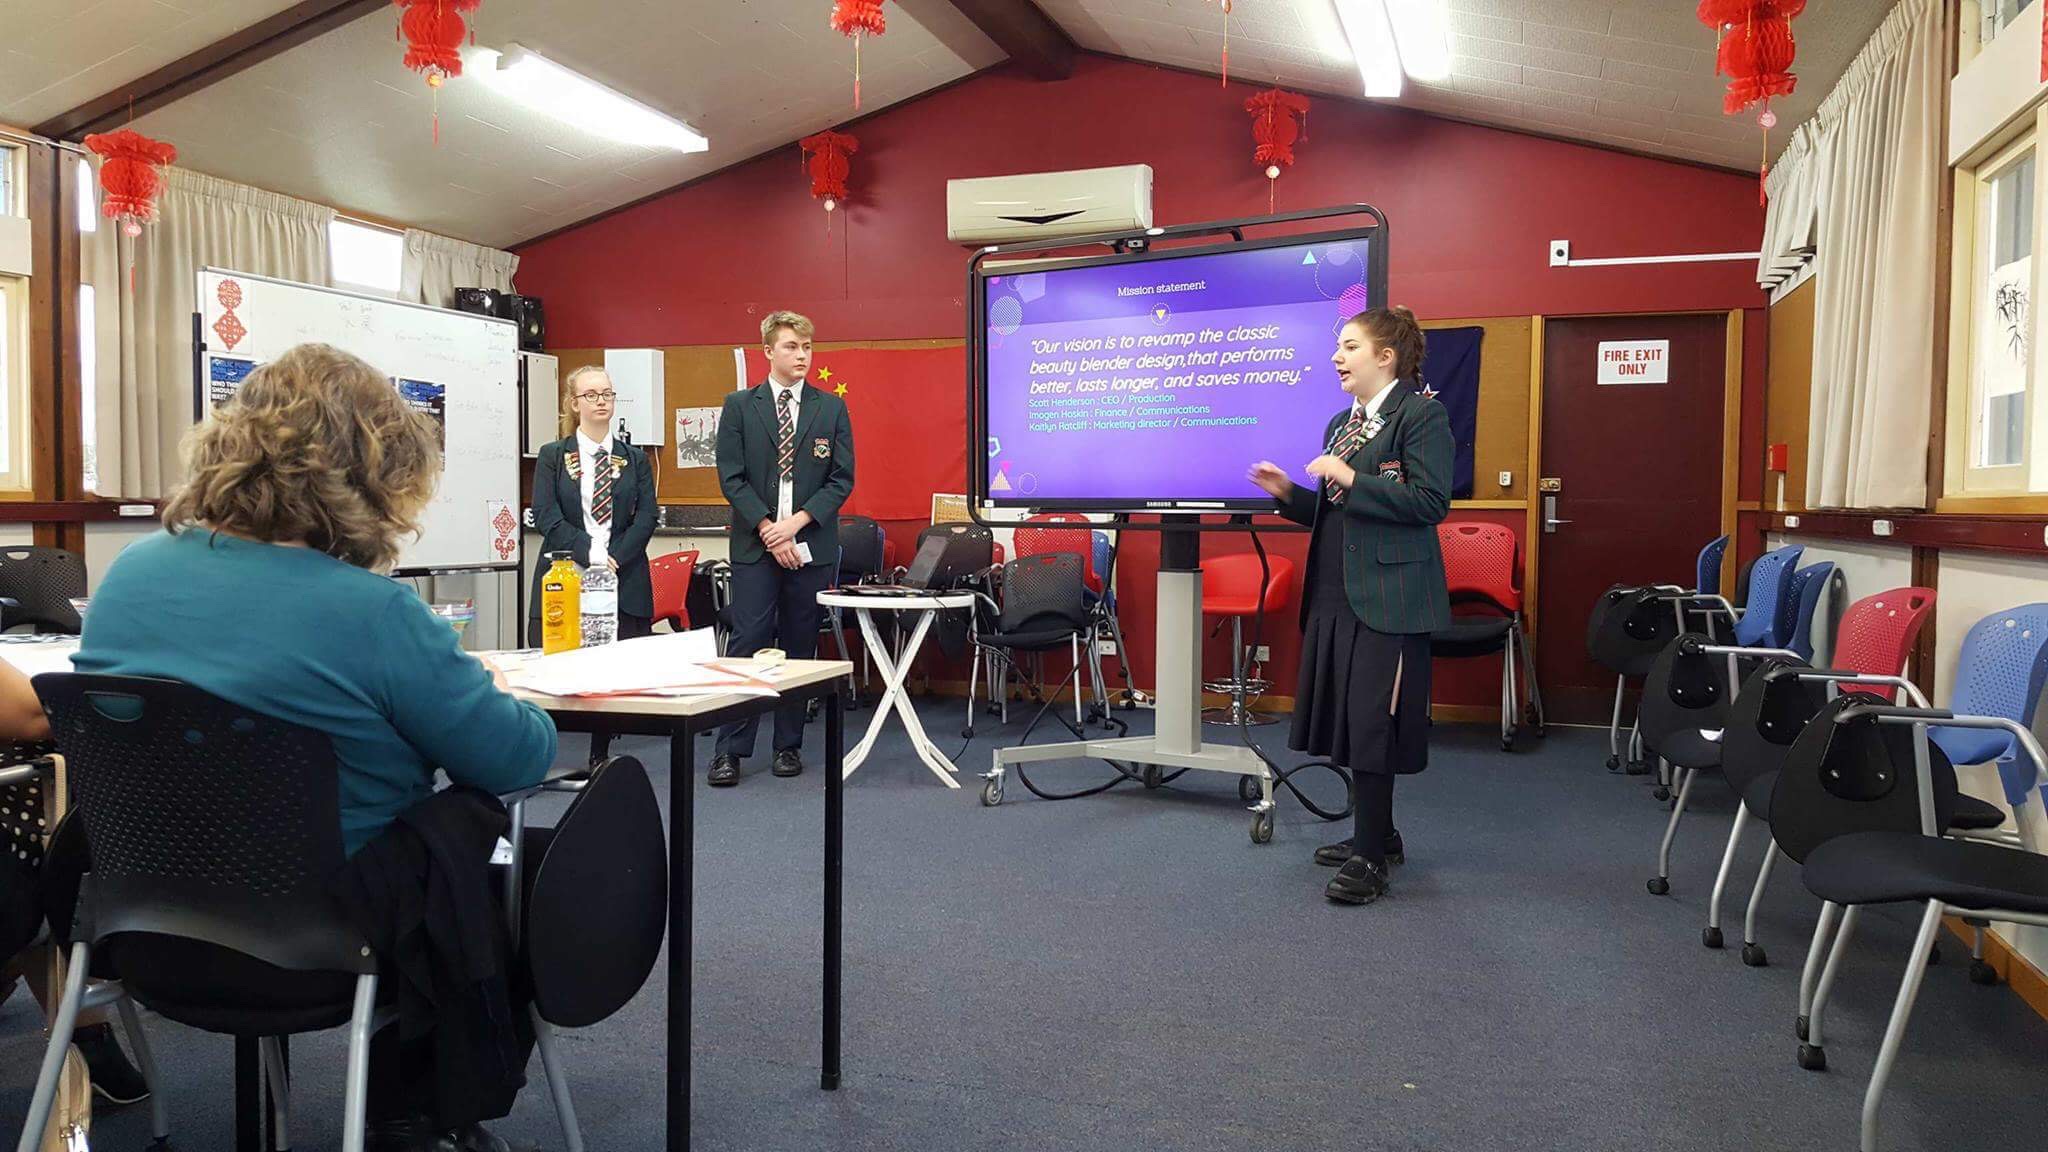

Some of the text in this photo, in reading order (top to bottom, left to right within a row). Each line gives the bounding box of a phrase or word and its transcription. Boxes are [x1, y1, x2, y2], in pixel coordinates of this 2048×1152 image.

[1117, 280, 1207, 297] Mission statement
[1064, 337, 1101, 352] vision
[1105, 336, 1116, 350] is
[1120, 335, 1134, 349] to
[1137, 331, 1195, 348] revamp
[1200, 327, 1223, 343] the
[1226, 324, 1280, 341] classic
[1029, 360, 1077, 376] beauty
[1079, 355, 1132, 372] blender
[1219, 347, 1296, 367] performs
[1604, 349, 1663, 361] FIRE EXIT
[1618, 363, 1647, 375] ONLY
[1029, 381, 1072, 395] better,
[1075, 377, 1108, 393] lasts
[1110, 376, 1159, 393] longer,
[1163, 372, 1194, 388] and
[1195, 371, 1240, 387] saves
[1028, 399, 1050, 408] Scott
[1051, 397, 1096, 408] Henderson
[1101, 395, 1120, 405] CEO
[1128, 393, 1176, 404] Production
[1029, 410, 1060, 421] Imogen
[1094, 408, 1128, 418] Finance
[1136, 405, 1210, 416] Communications
[1029, 422, 1057, 433] Kaitlyn
[1059, 420, 1088, 431] Ratcliff
[1093, 419, 1136, 431] Marketing
[1137, 419, 1171, 429] director
[1180, 416, 1258, 428] Communications
